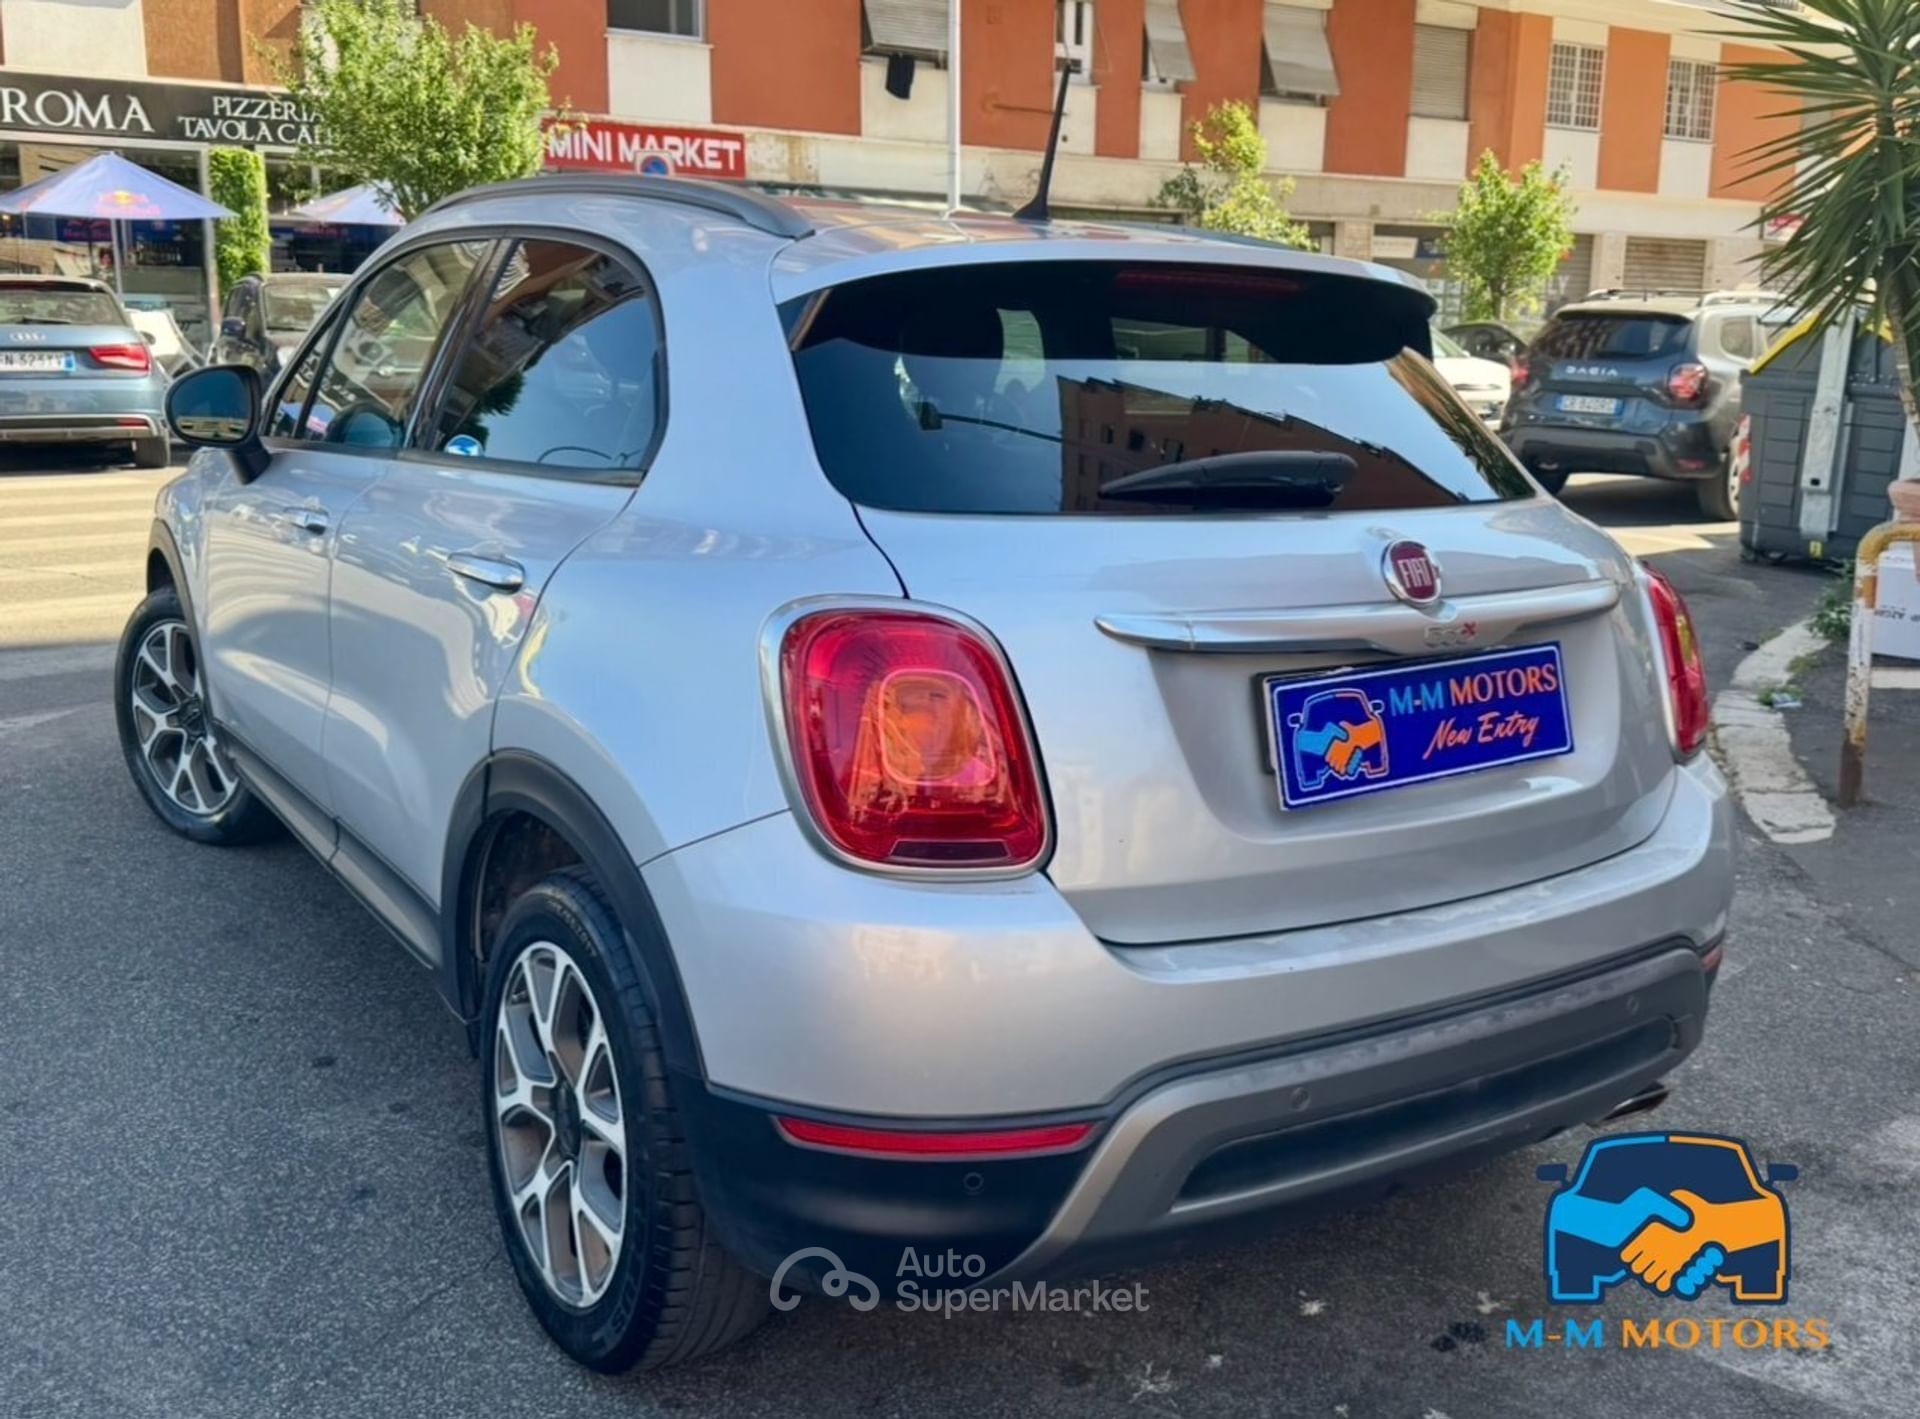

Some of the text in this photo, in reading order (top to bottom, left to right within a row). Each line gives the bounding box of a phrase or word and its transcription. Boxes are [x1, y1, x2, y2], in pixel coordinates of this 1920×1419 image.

[1, 87, 155, 133] ROMA
[178, 116, 274, 143] TAVOLA
[549, 129, 742, 171] MINI MARKET
[1565, 364, 1618, 378] DACIA
[1397, 557, 1432, 589] FIAT
[1389, 663, 1558, 717] M-M MOTORS
[1422, 710, 1539, 761] New Entry
